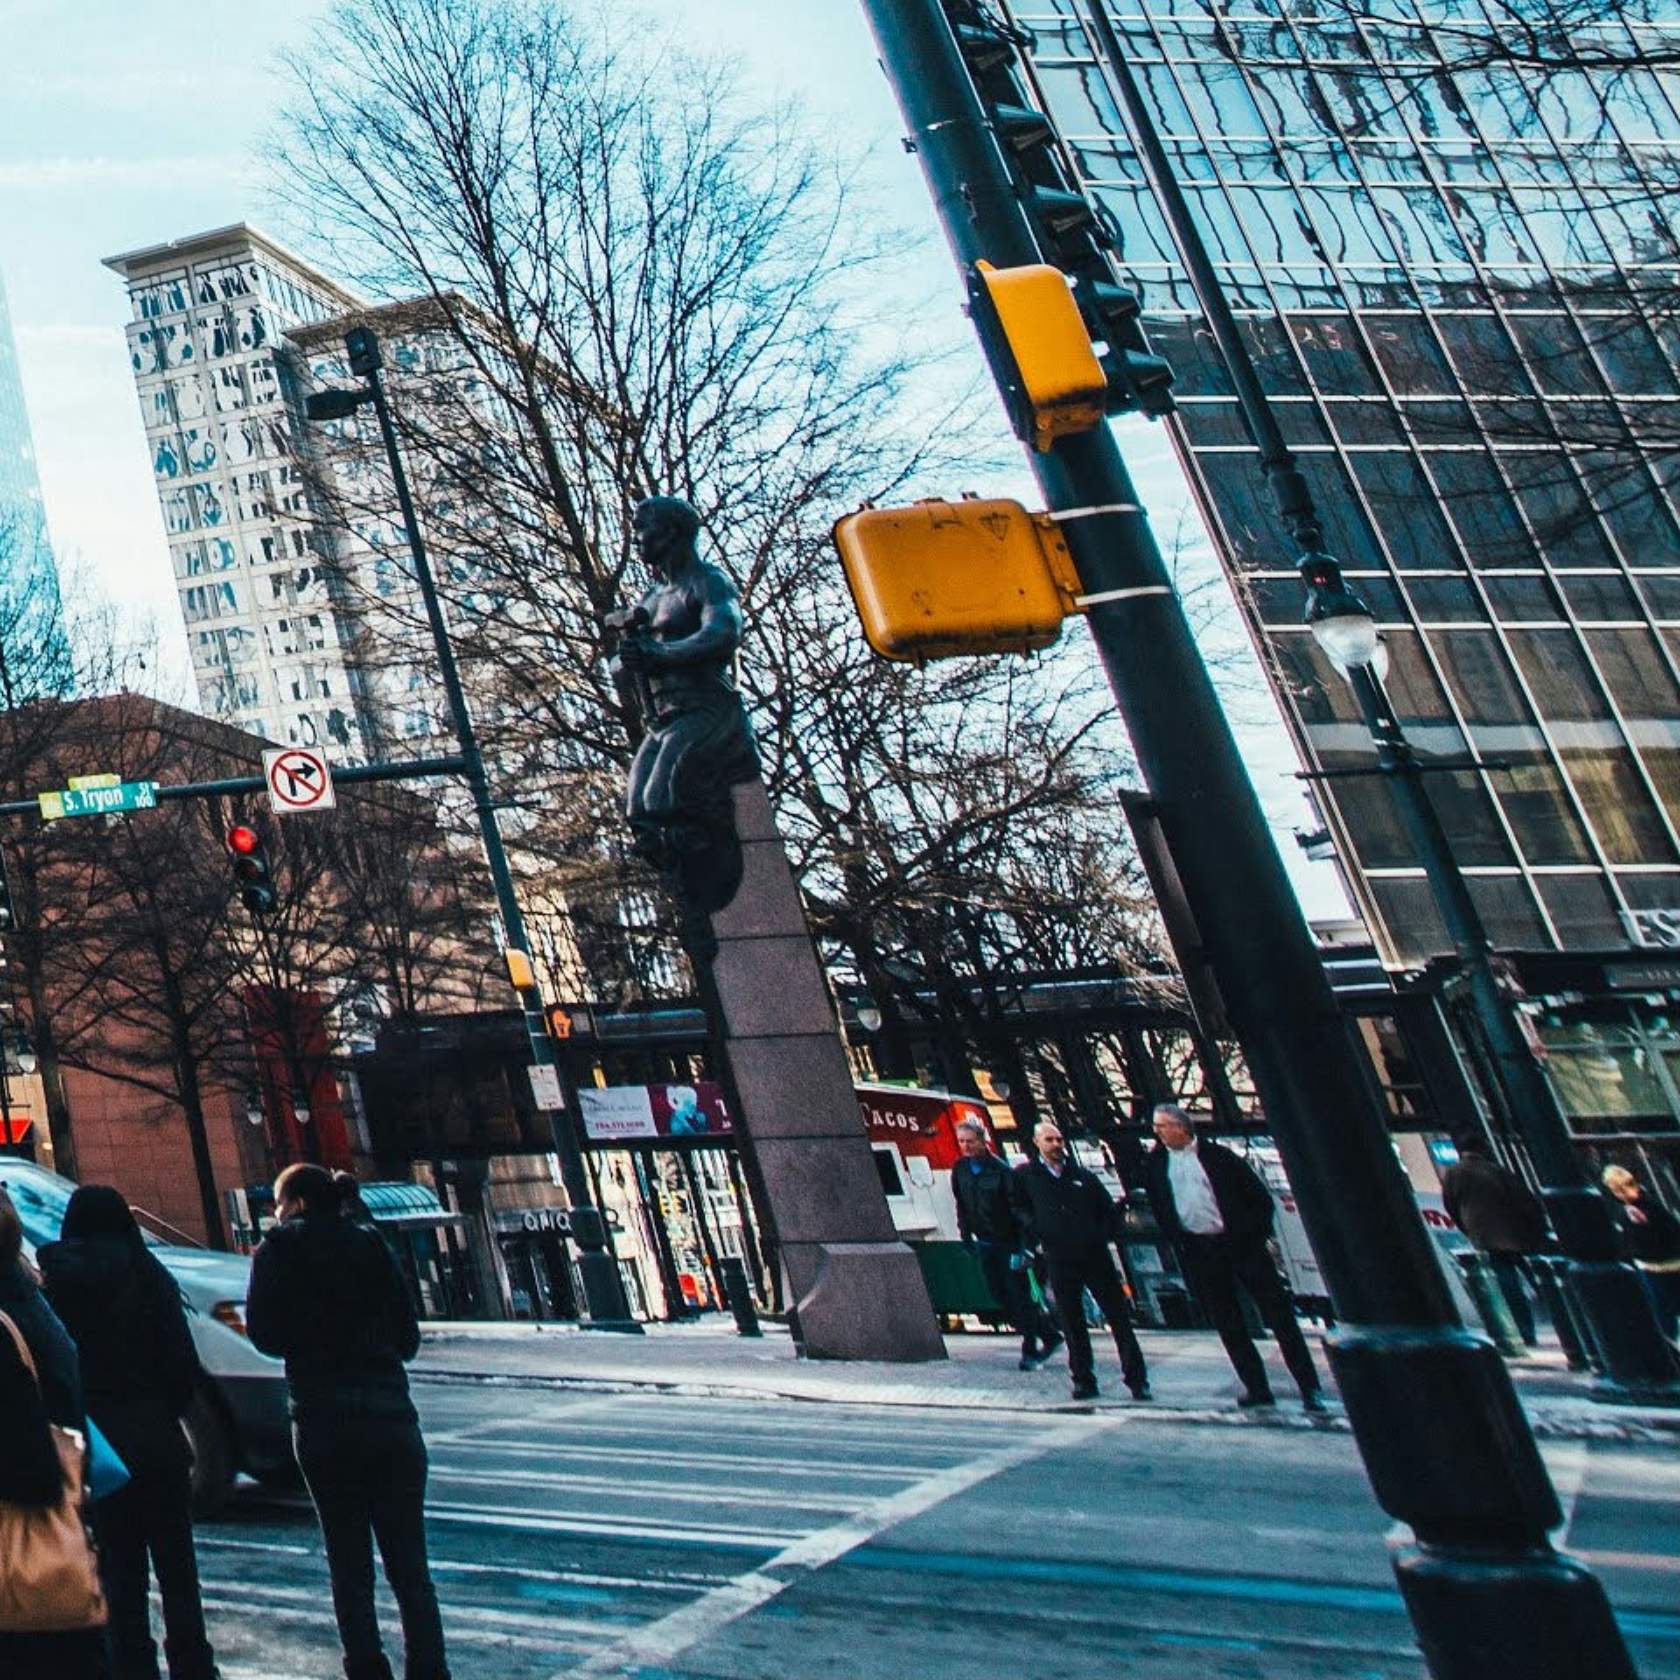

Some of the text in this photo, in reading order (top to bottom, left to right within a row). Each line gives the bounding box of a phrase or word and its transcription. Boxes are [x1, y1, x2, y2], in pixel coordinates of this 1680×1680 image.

[62, 787, 124, 812] S. Tryon
[1618, 908, 1680, 948] ES
